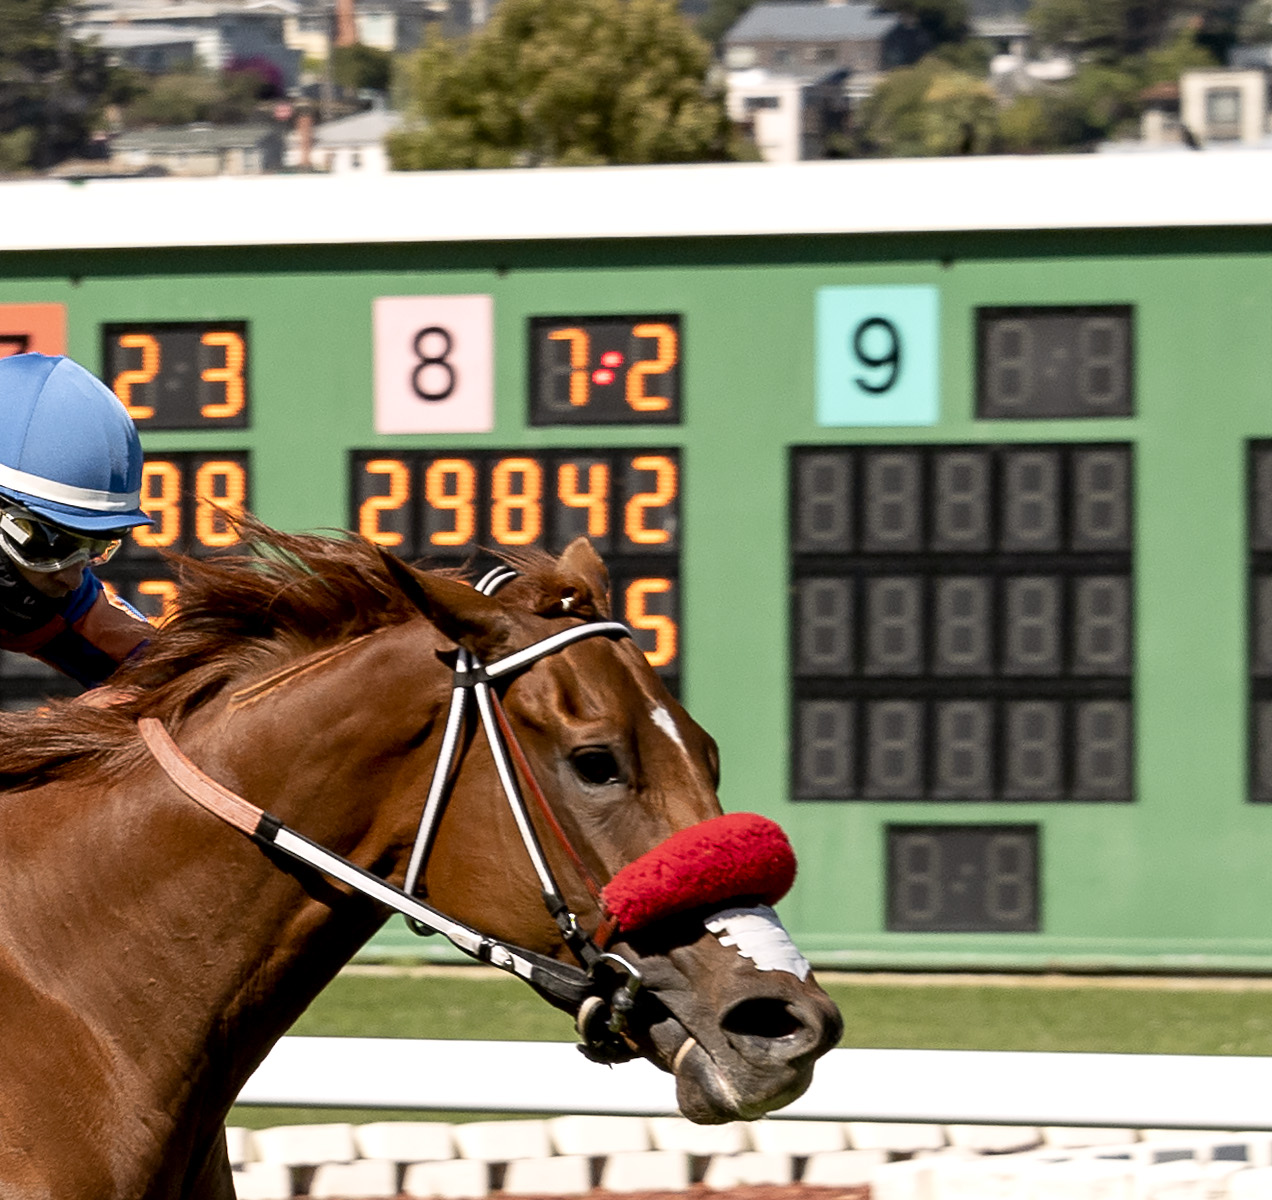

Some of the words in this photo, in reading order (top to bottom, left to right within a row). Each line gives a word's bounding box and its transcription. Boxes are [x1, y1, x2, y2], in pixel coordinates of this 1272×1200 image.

[410, 325, 458, 403] 8
[852, 316, 902, 395] 9
[359, 456, 678, 547] 29842
